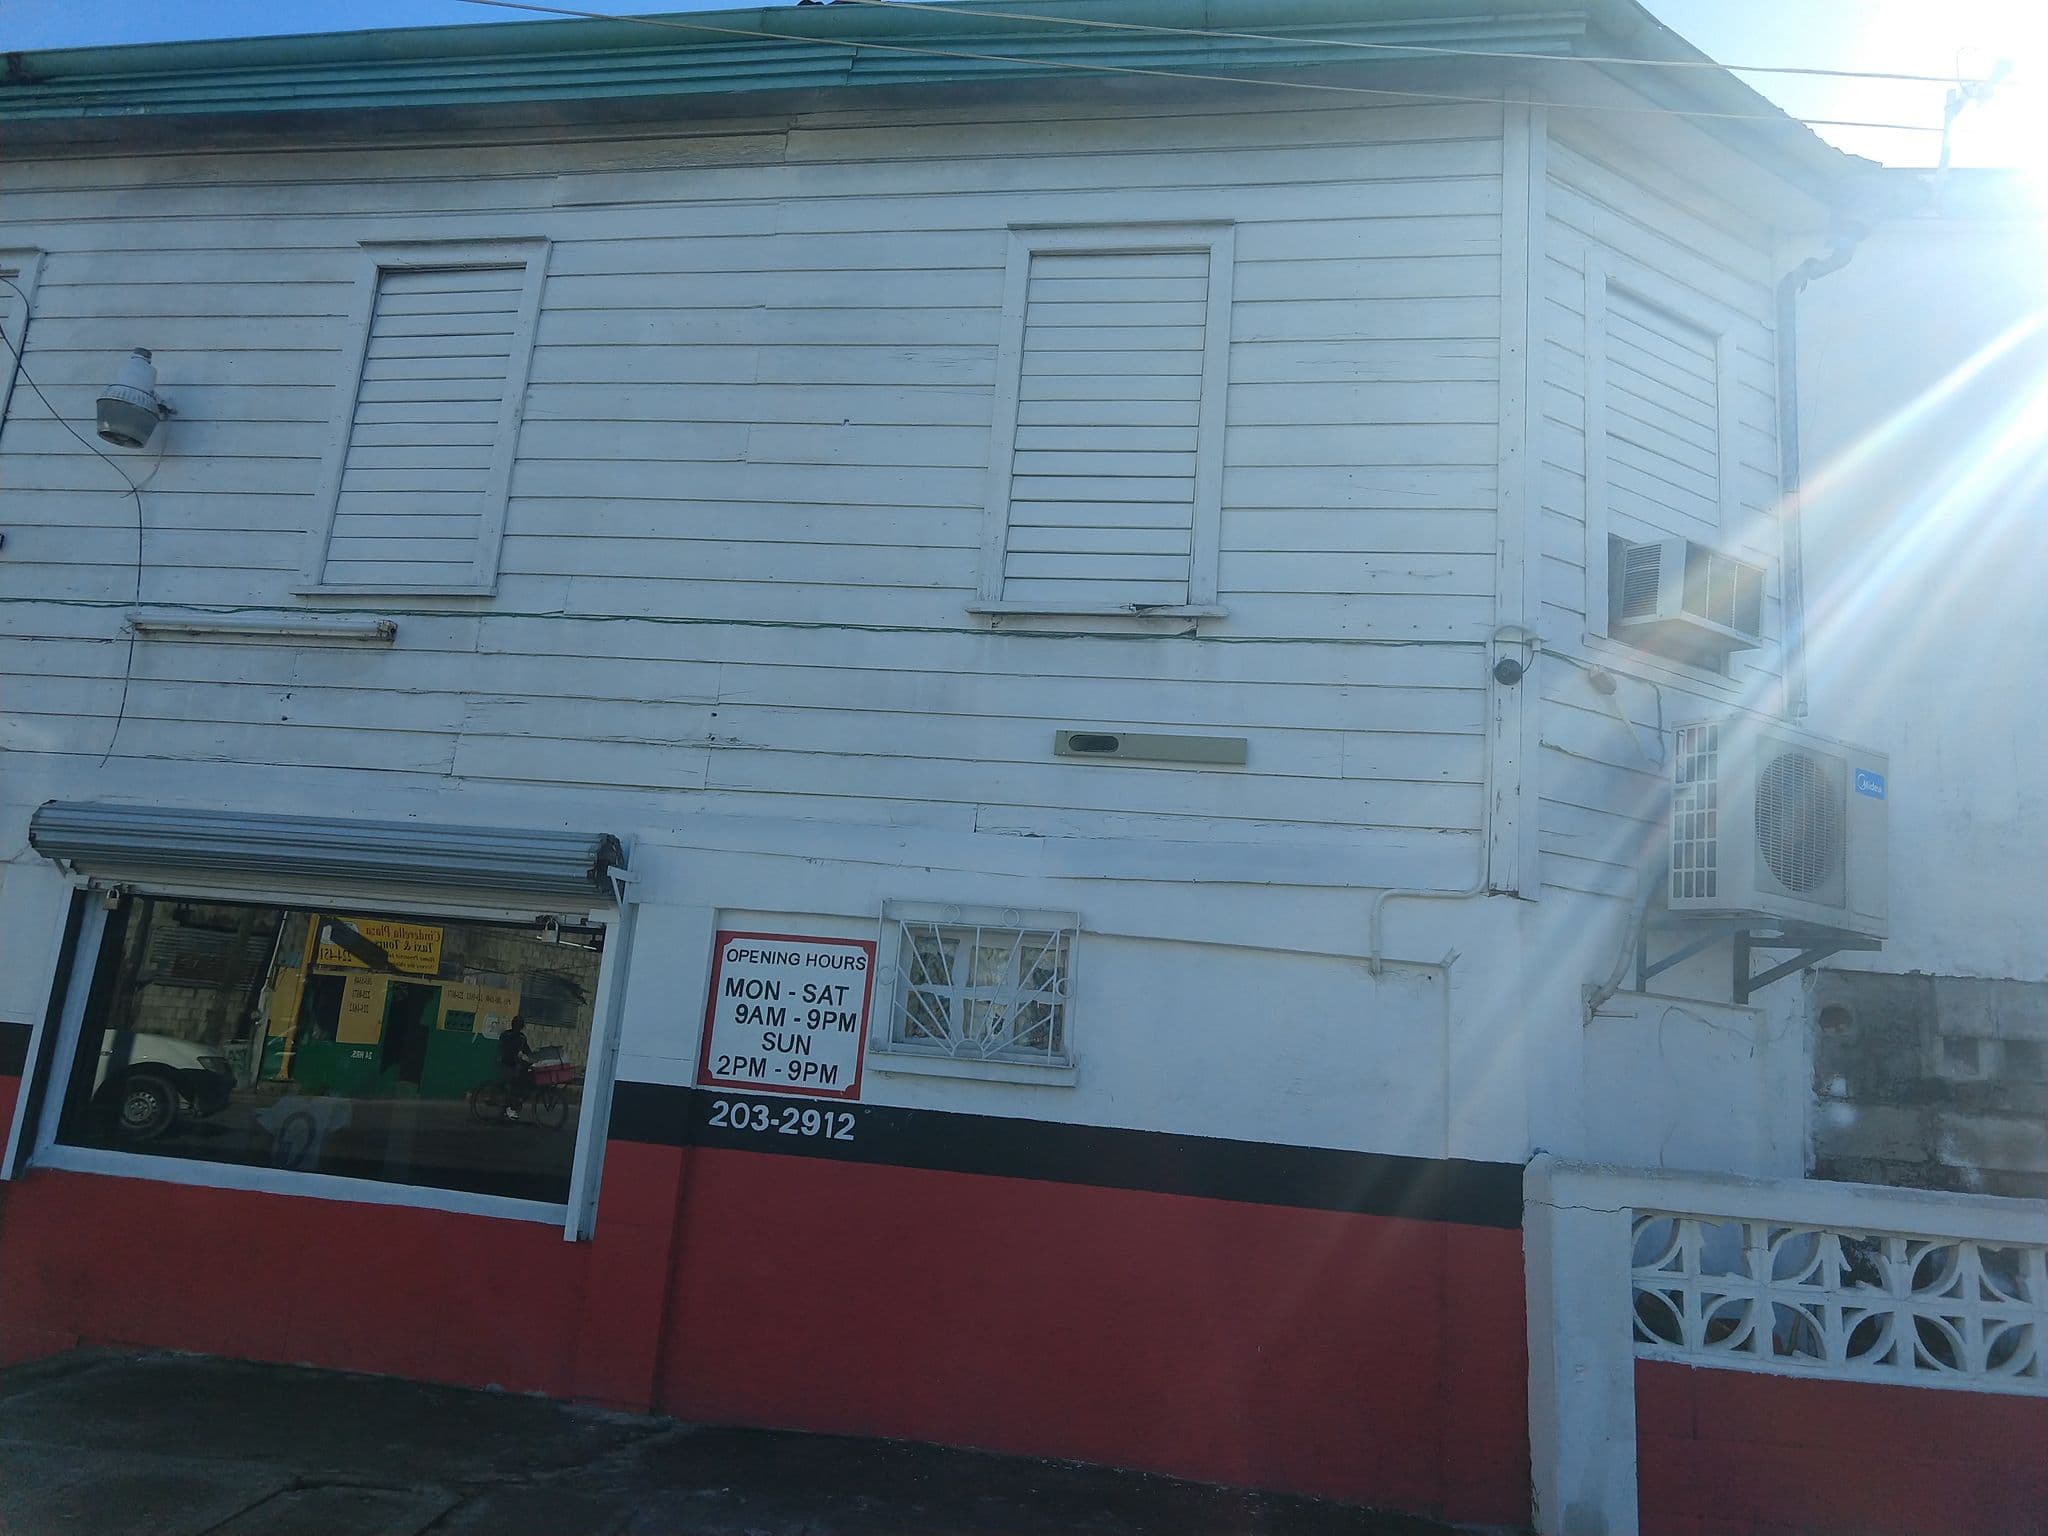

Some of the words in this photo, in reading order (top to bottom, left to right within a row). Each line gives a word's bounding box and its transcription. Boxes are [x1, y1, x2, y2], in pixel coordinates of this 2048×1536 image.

[726, 948, 801, 966] OPENING
[805, 953, 867, 971] HOURS
[725, 977, 781, 1001] MON
[802, 983, 850, 1006] SAT
[734, 1003, 787, 1027] 9AM
[806, 1008, 857, 1033] 9PM
[761, 1031, 812, 1056] SUN
[716, 1054, 767, 1078] 2PM
[787, 1059, 839, 1085] 9PM
[708, 1100, 856, 1141] 203-2912
